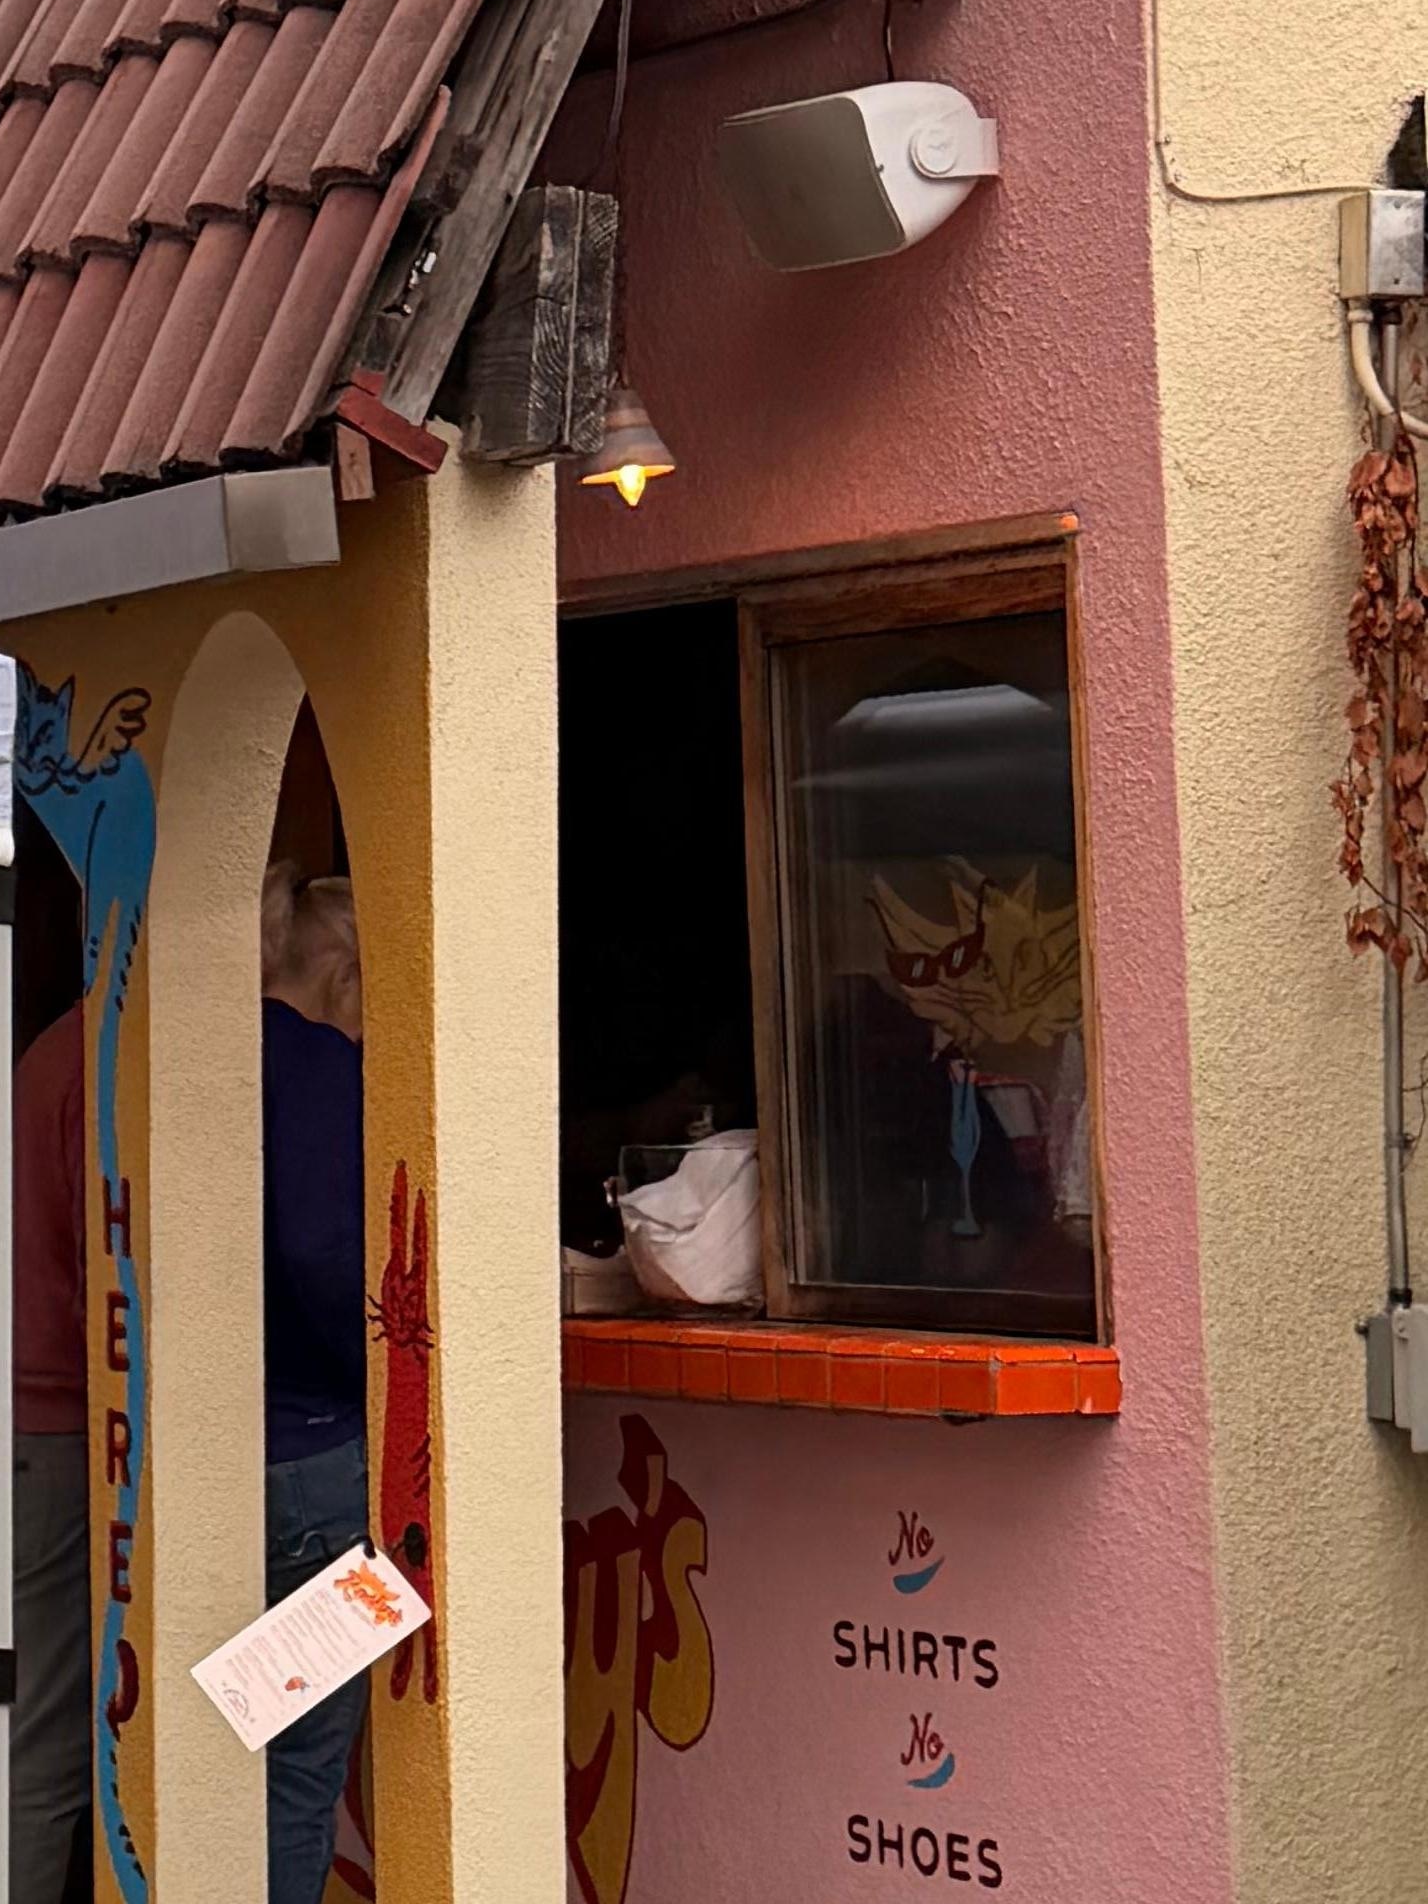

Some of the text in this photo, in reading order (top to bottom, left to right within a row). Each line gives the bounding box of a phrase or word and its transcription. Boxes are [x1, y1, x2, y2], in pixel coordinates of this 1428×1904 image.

[102, 1176, 133, 1604] HERE
[889, 1511, 934, 1566] No
[832, 1620, 999, 1689] SHIRTS
[900, 1713, 944, 1767] No
[847, 1814, 1003, 1889] SHOES
